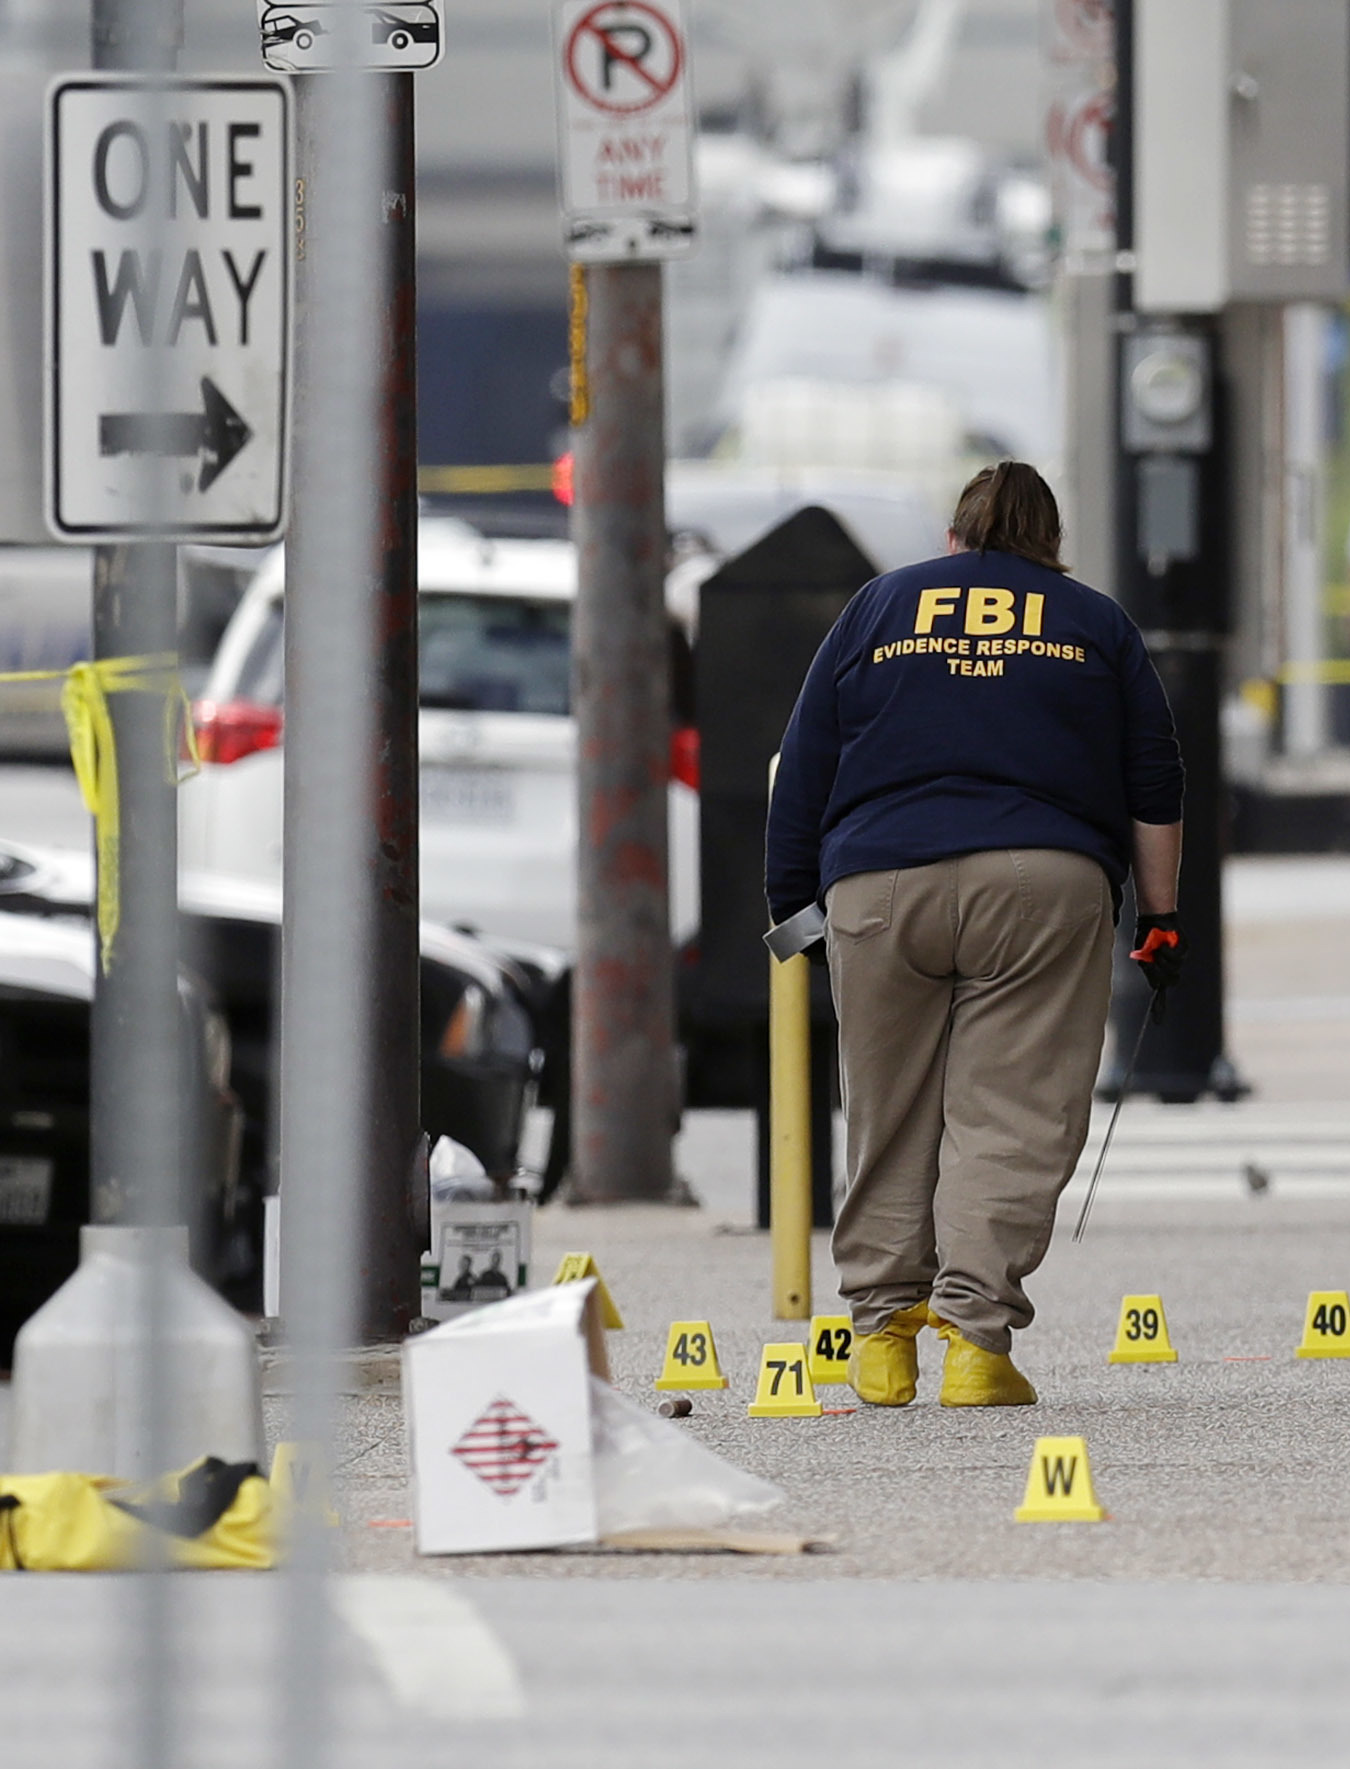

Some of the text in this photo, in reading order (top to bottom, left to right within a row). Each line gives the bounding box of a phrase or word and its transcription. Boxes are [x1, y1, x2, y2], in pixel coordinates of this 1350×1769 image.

[597, 137, 666, 164] ANY
[93, 119, 263, 221] ONE
[91, 248, 266, 347] WAY
[914, 587, 1045, 636] FBI
[873, 637, 1085, 663] EVIDENCE RESPONSE
[947, 658, 1004, 677] TEAM
[1125, 1308, 1159, 1341] 39
[1313, 1304, 1346, 1336] 40
[673, 1332, 707, 1366] 43
[815, 1328, 852, 1361] 42
[766, 1359, 804, 1396] 71
[1041, 1455, 1078, 1497] W
